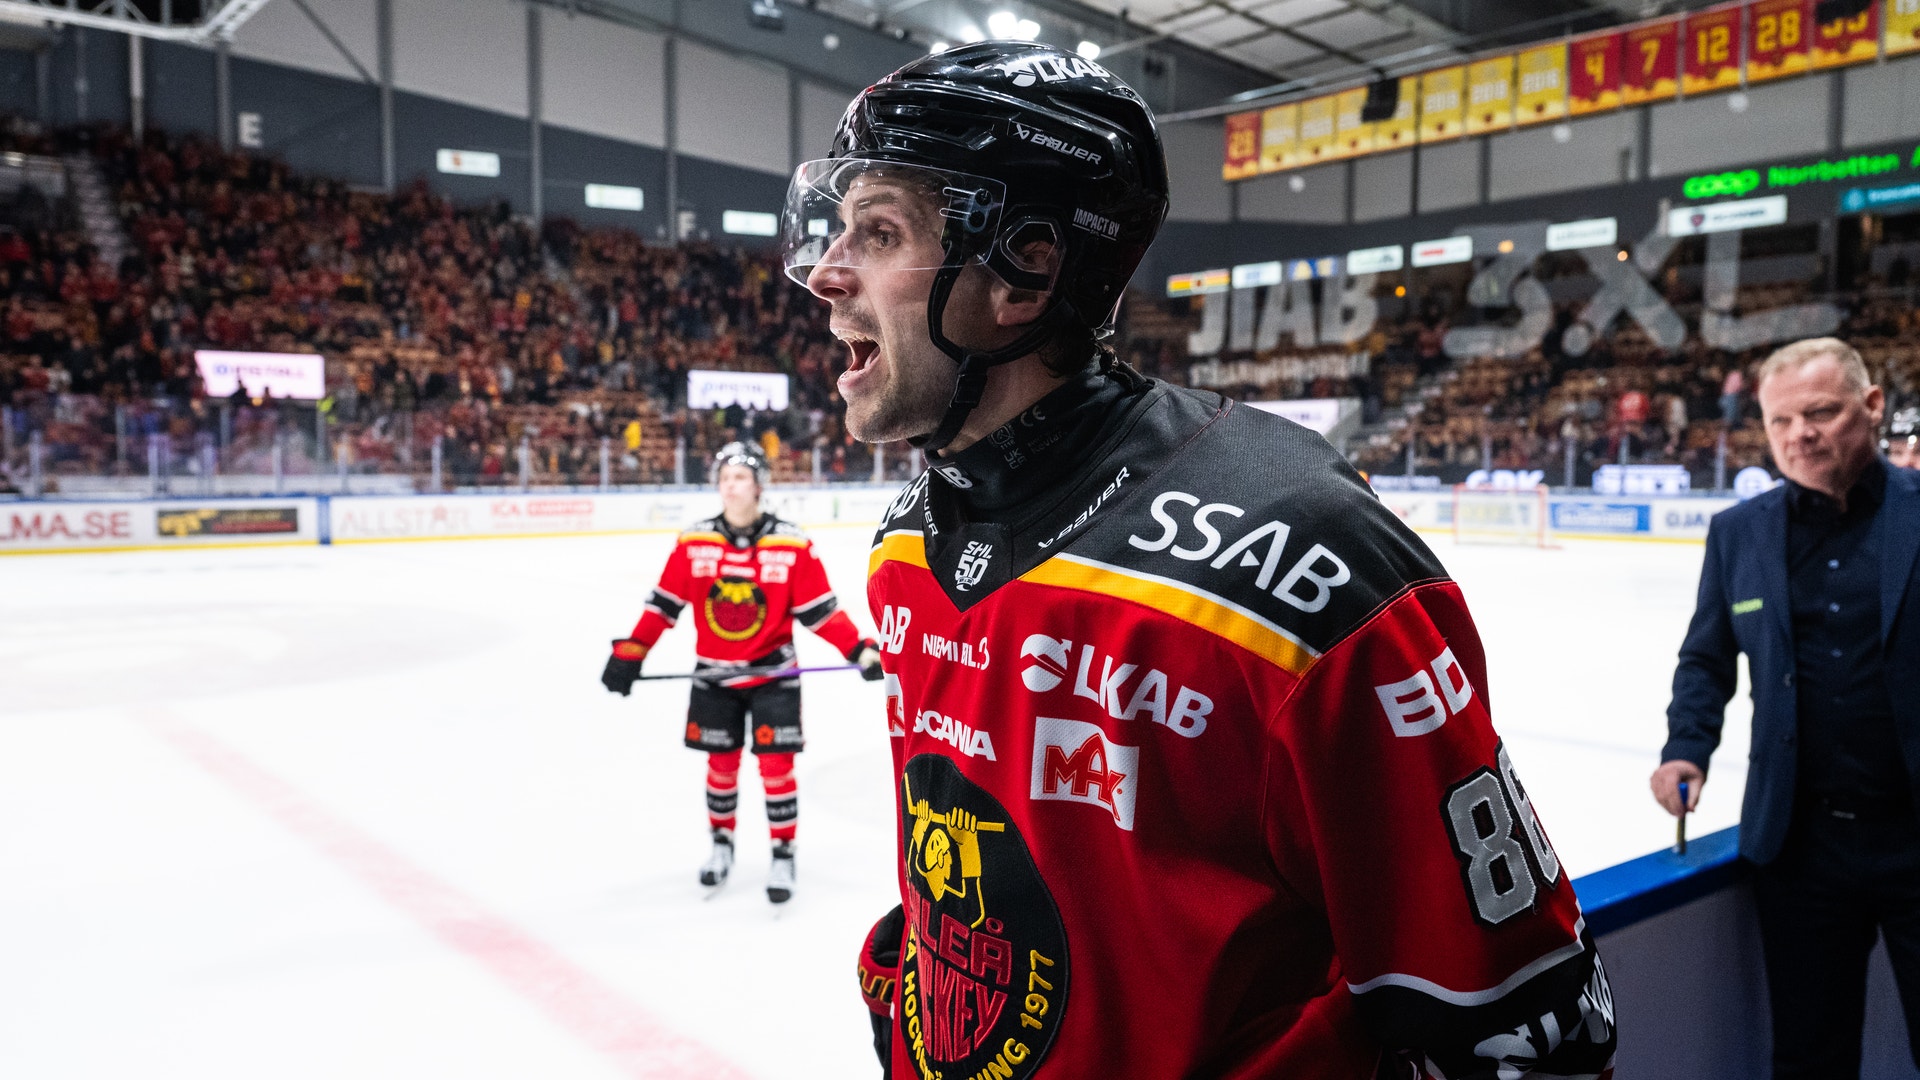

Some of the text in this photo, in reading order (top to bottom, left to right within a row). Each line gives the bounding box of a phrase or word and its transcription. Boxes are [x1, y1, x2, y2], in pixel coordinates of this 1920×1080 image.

[1697, 26, 1731, 64] 12
[1757, 10, 1799, 51] 28
[1031, 56, 1111, 83] LKAB
[1585, 52, 1604, 86] 4
[1640, 40, 1660, 76] 7
[239, 113, 263, 148] E
[1031, 132, 1102, 165] BAUER
[1073, 207, 1121, 237] IMPACT BY
[339, 504, 473, 535] ALLSTAR
[963, 541, 993, 559] SHL
[1128, 490, 1351, 614] SSAB
[955, 553, 989, 586] 50
[922, 633, 958, 662] NIEMI
[1073, 644, 1215, 739] LKAB
[913, 707, 998, 762] SCANIA
[1042, 733, 1127, 821] MAX
[1443, 738, 1561, 925] 86
[1020, 950, 1055, 1030] 1977
